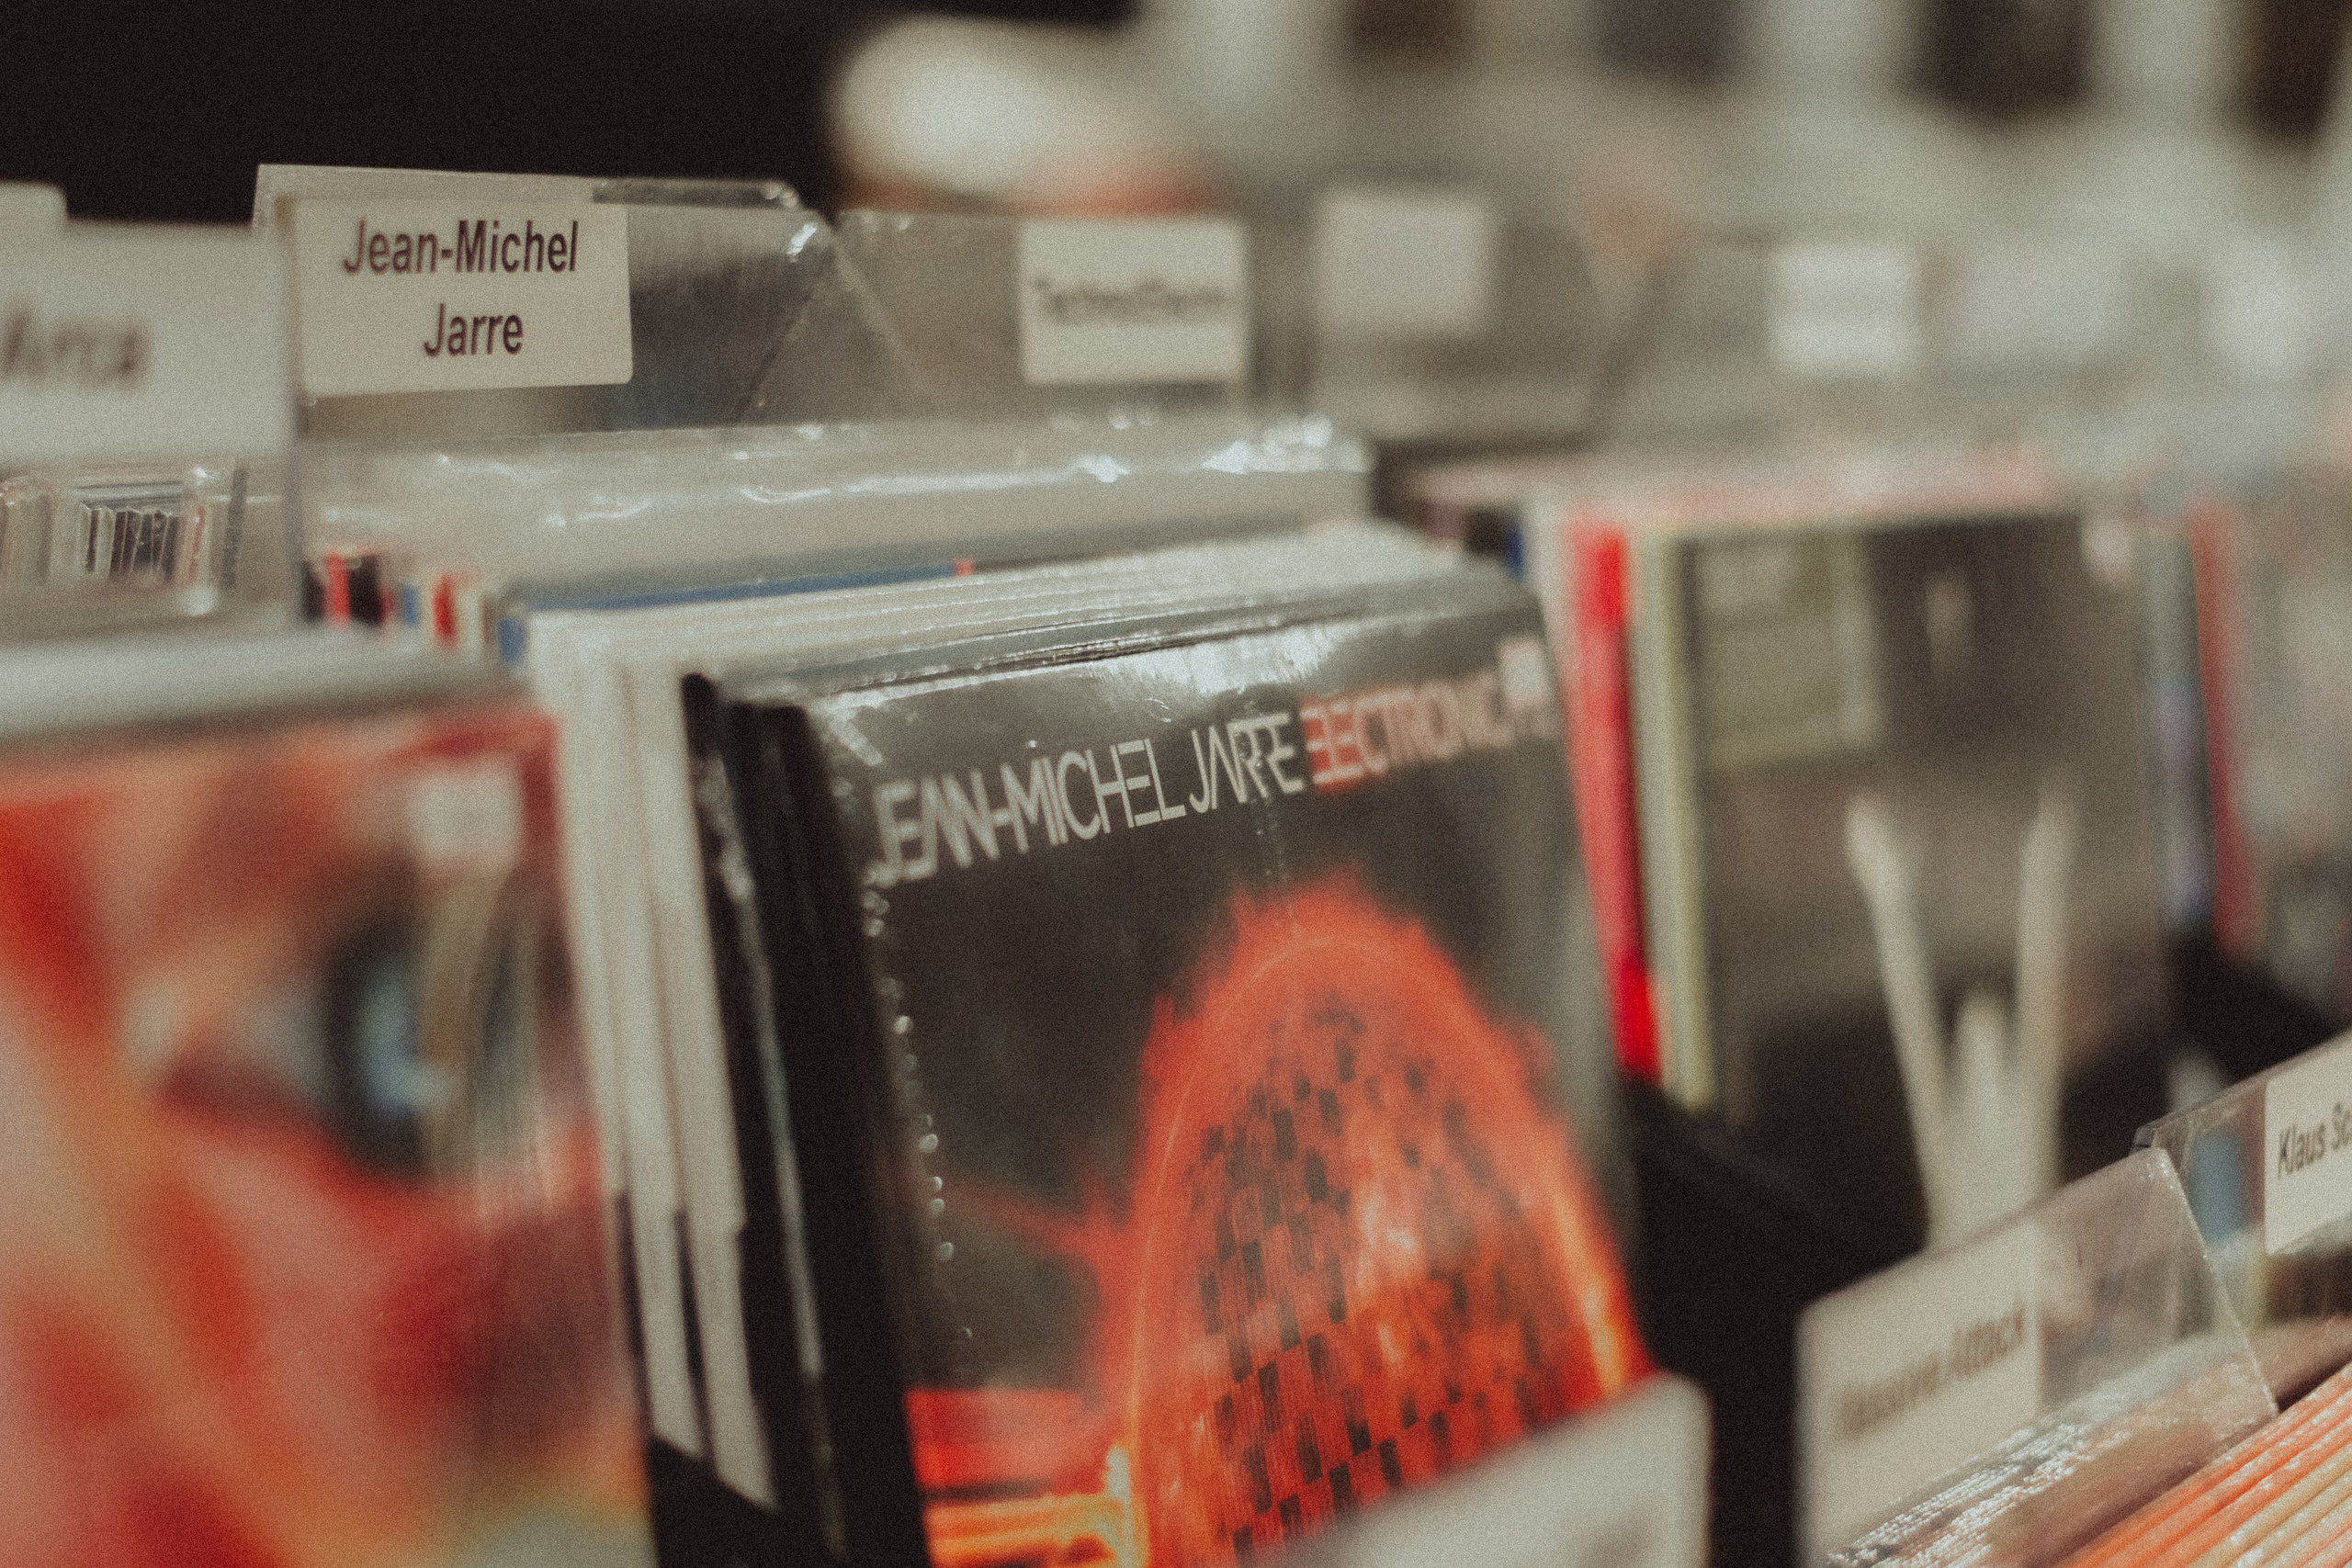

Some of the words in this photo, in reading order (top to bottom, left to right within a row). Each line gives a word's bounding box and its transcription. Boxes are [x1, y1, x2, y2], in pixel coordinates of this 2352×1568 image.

[343, 220, 579, 274] Jean-Michel
[424, 302, 524, 356] Jarre
[864, 738, 1186, 887] JEAN-MICHEL
[1189, 713, 1305, 814] JARRE
[2278, 1122, 2325, 1179] Klaus
